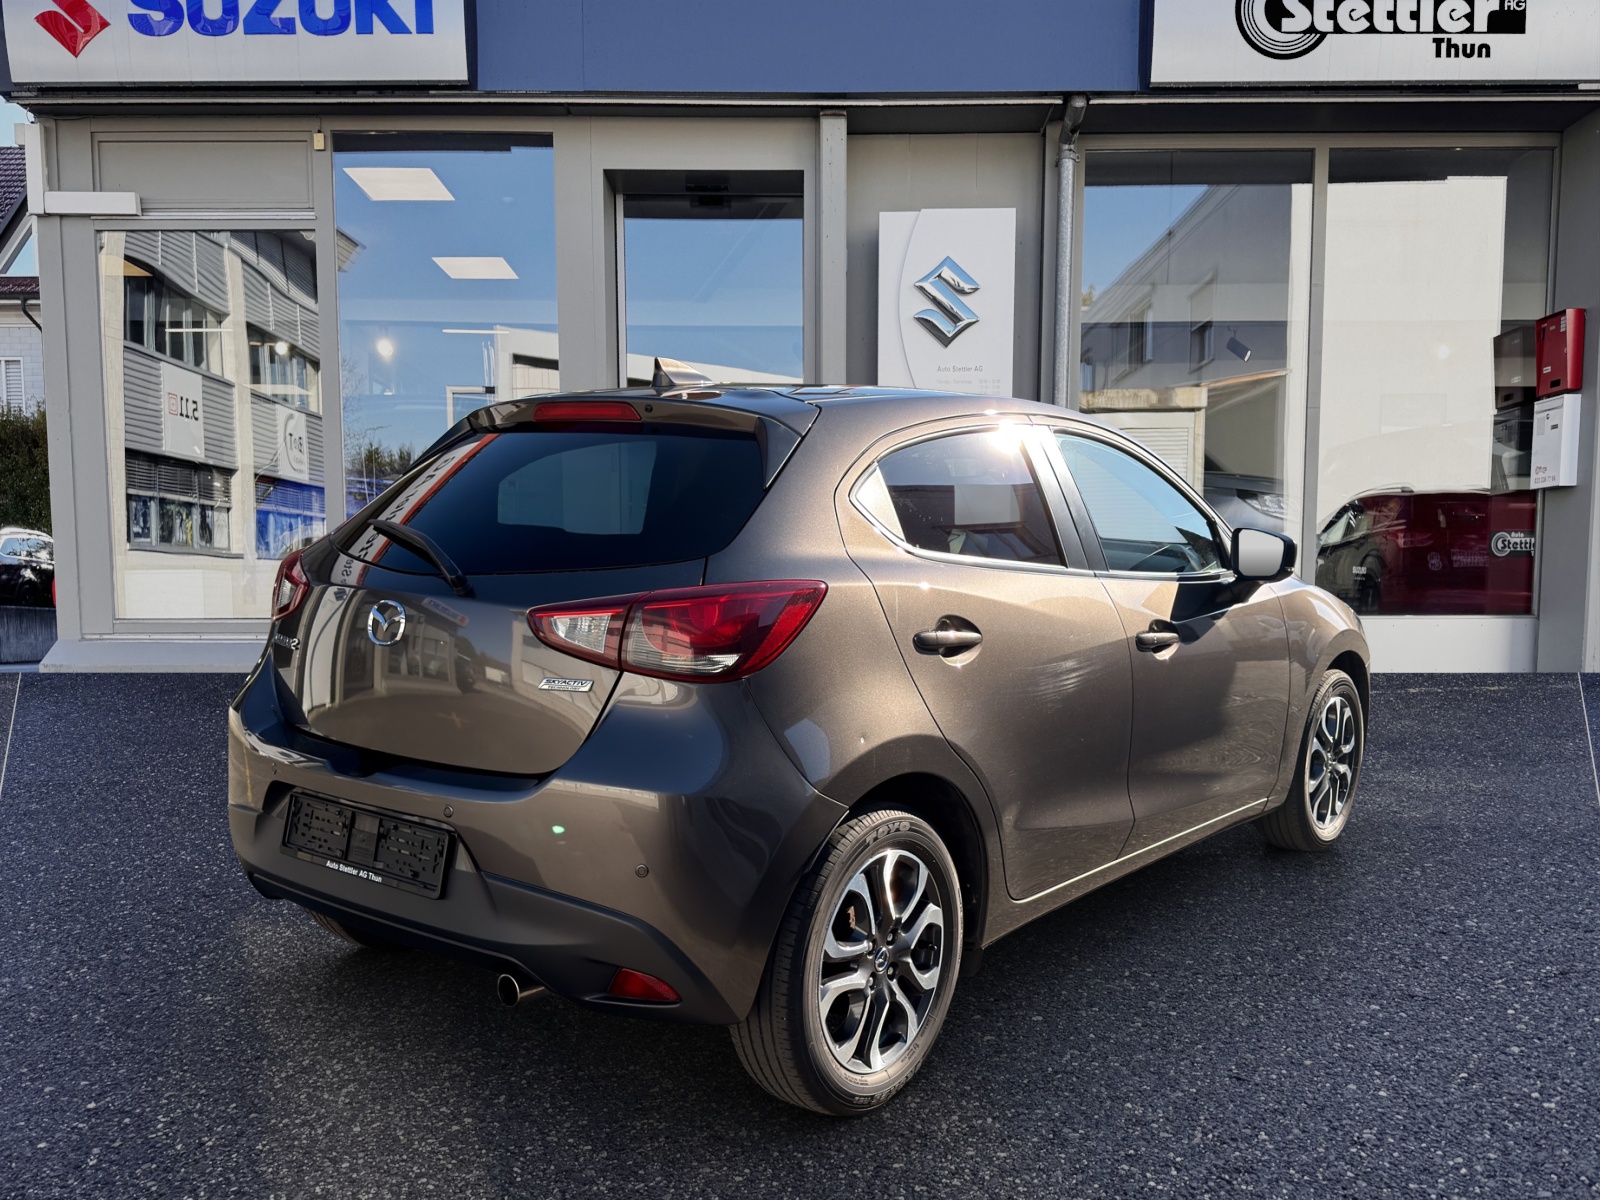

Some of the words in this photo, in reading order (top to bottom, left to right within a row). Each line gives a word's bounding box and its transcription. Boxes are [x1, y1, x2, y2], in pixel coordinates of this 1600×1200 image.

[128, 0, 434, 36] SUZUKI
[1432, 38, 1491, 58] Thun
[1501, 538, 1534, 550] Stettl
[865, 821, 911, 846] TOYO
[326, 860, 338, 870] Auto
[339, 863, 358, 876] Stettler
[359, 869, 367, 878] AG
[369, 872, 382, 883] Thun
